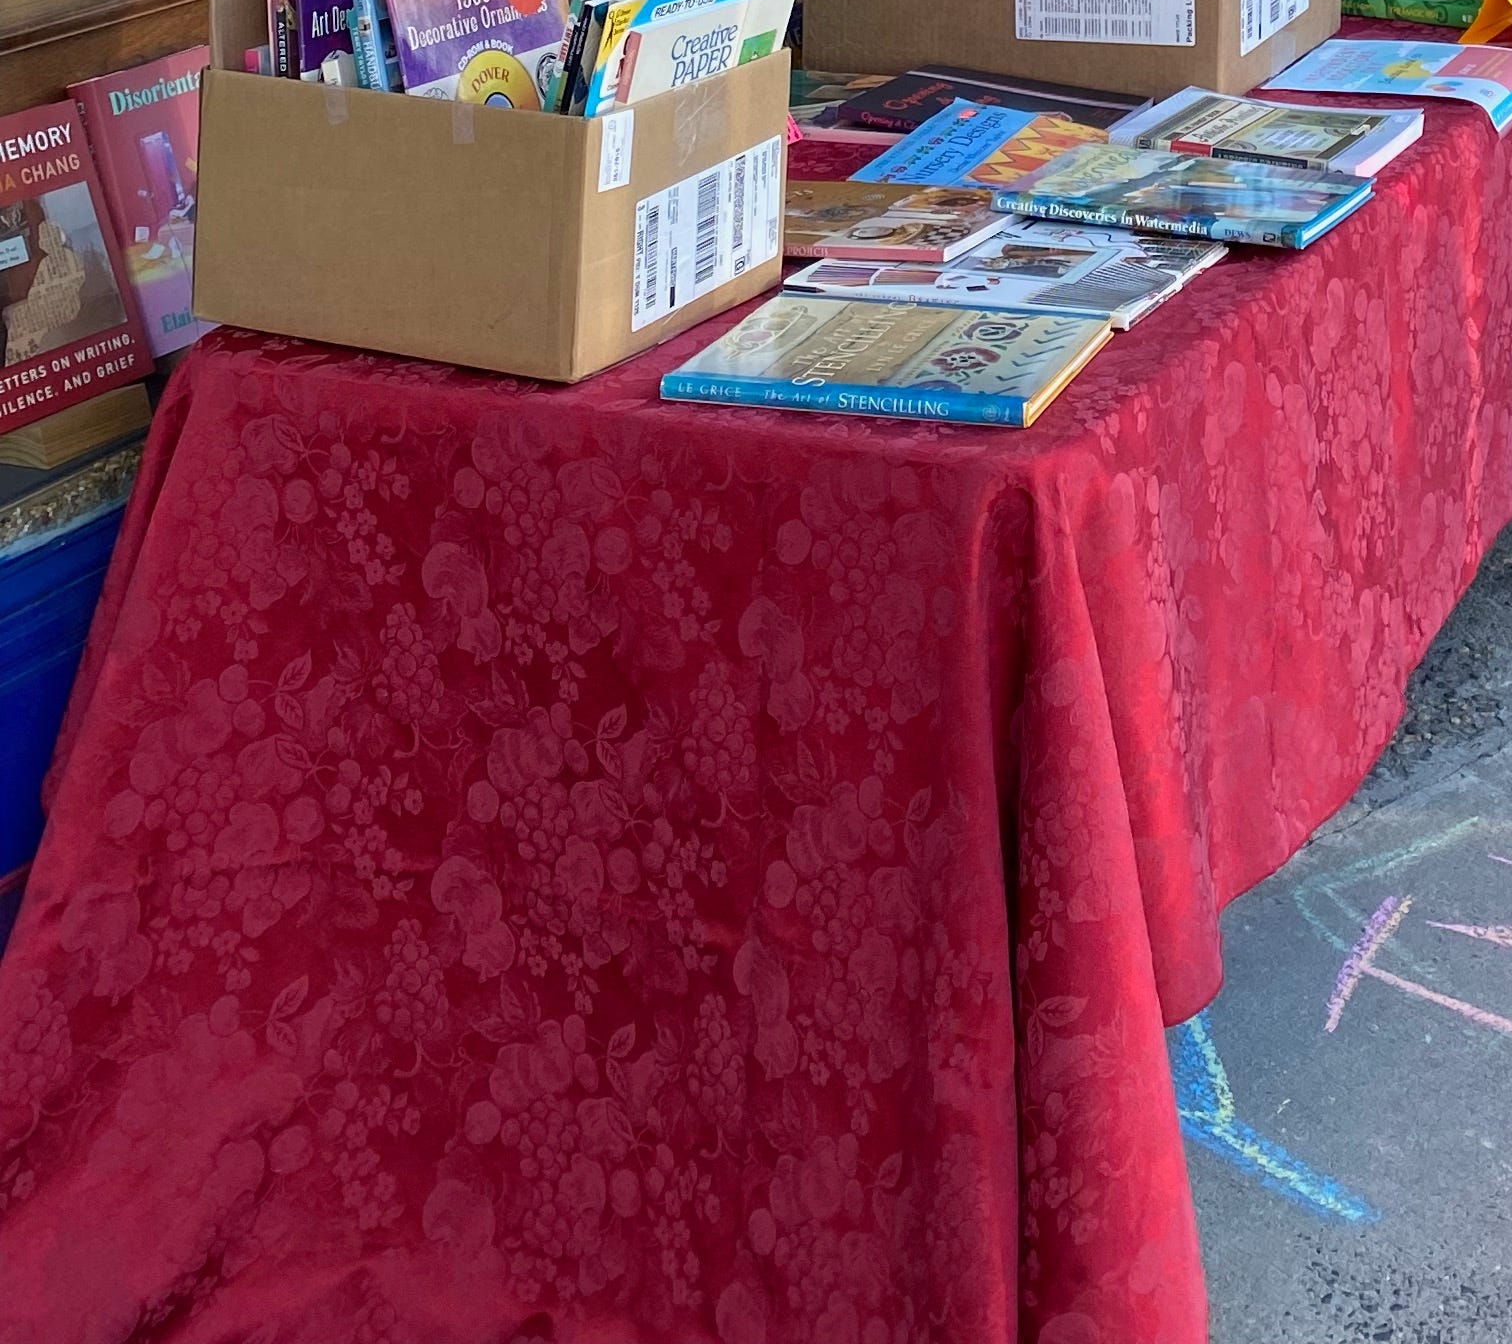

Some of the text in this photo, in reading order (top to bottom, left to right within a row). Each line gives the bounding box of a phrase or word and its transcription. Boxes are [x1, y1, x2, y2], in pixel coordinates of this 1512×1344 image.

[311, 9, 330, 39] Art
[407, 13, 479, 52] Decorative
[671, 23, 739, 62] Creative
[1185, 8, 1194, 43] Packing
[277, 20, 287, 73] ALTERED
[491, 38, 514, 54] BOOK
[472, 66, 510, 95] DOVER
[671, 44, 733, 88] PAPER
[108, 70, 200, 117] Disorienta
[957, 111, 1009, 148] Designs
[20, 153, 82, 186] CHANG
[996, 196, 1048, 218] Creative
[1048, 202, 1118, 225] Discoveries
[1120, 210, 1134, 226] in
[1134, 213, 1209, 237] Watermedia
[792, 301, 918, 387] STENCILLING
[51, 357, 71, 373] ON
[64, 371, 92, 393] AND
[96, 352, 136, 381] GRIEF
[677, 383, 694, 395] LE
[698, 384, 742, 398] GRICE
[838, 392, 950, 416] STENCILLING
